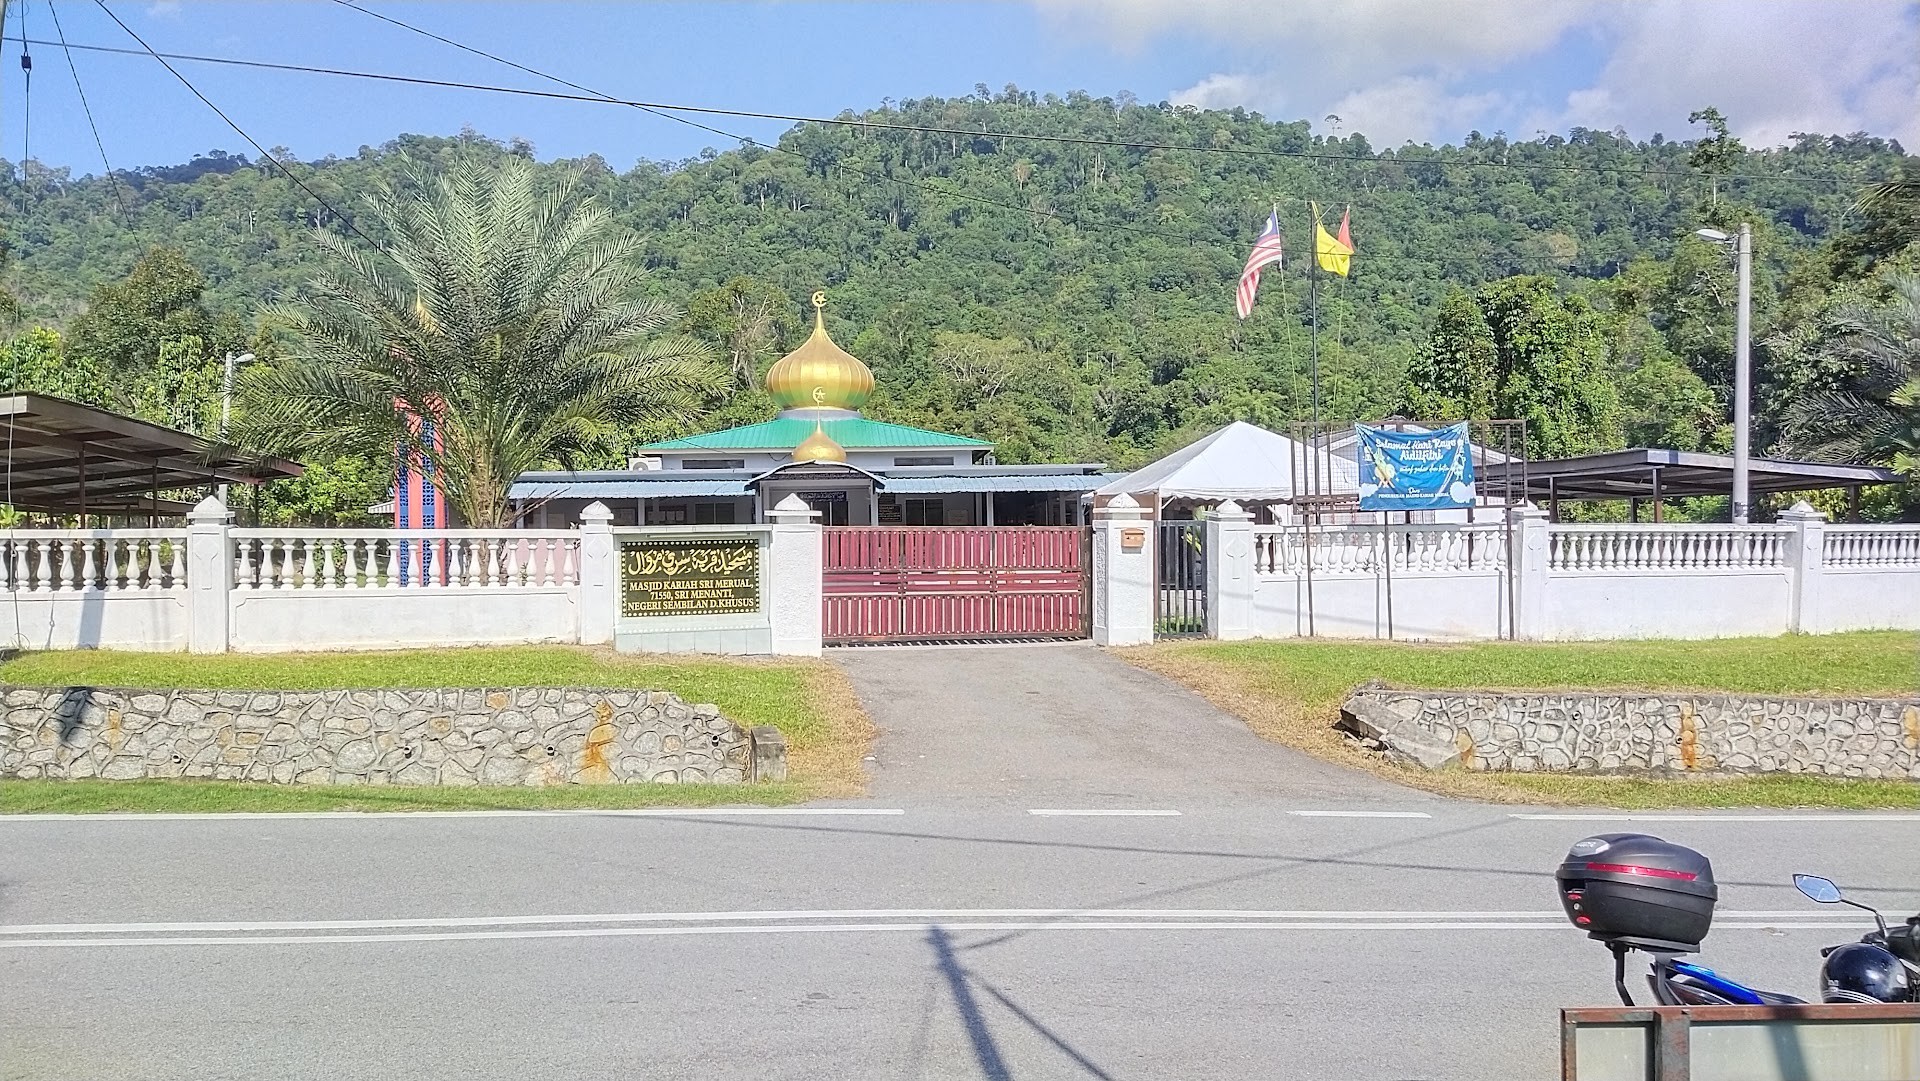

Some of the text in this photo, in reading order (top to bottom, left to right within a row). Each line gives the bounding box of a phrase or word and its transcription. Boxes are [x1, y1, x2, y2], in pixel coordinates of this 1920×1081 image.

[1376, 438, 1457, 450] Selamat Hari Raya
[630, 578, 754, 592] MASJID KARIAH SRI MERUAL,
[650, 589, 734, 601] 71550, SRI MENANTI,
[628, 598, 754, 611] NEGERI SEMBILAN D.KHUSUS
